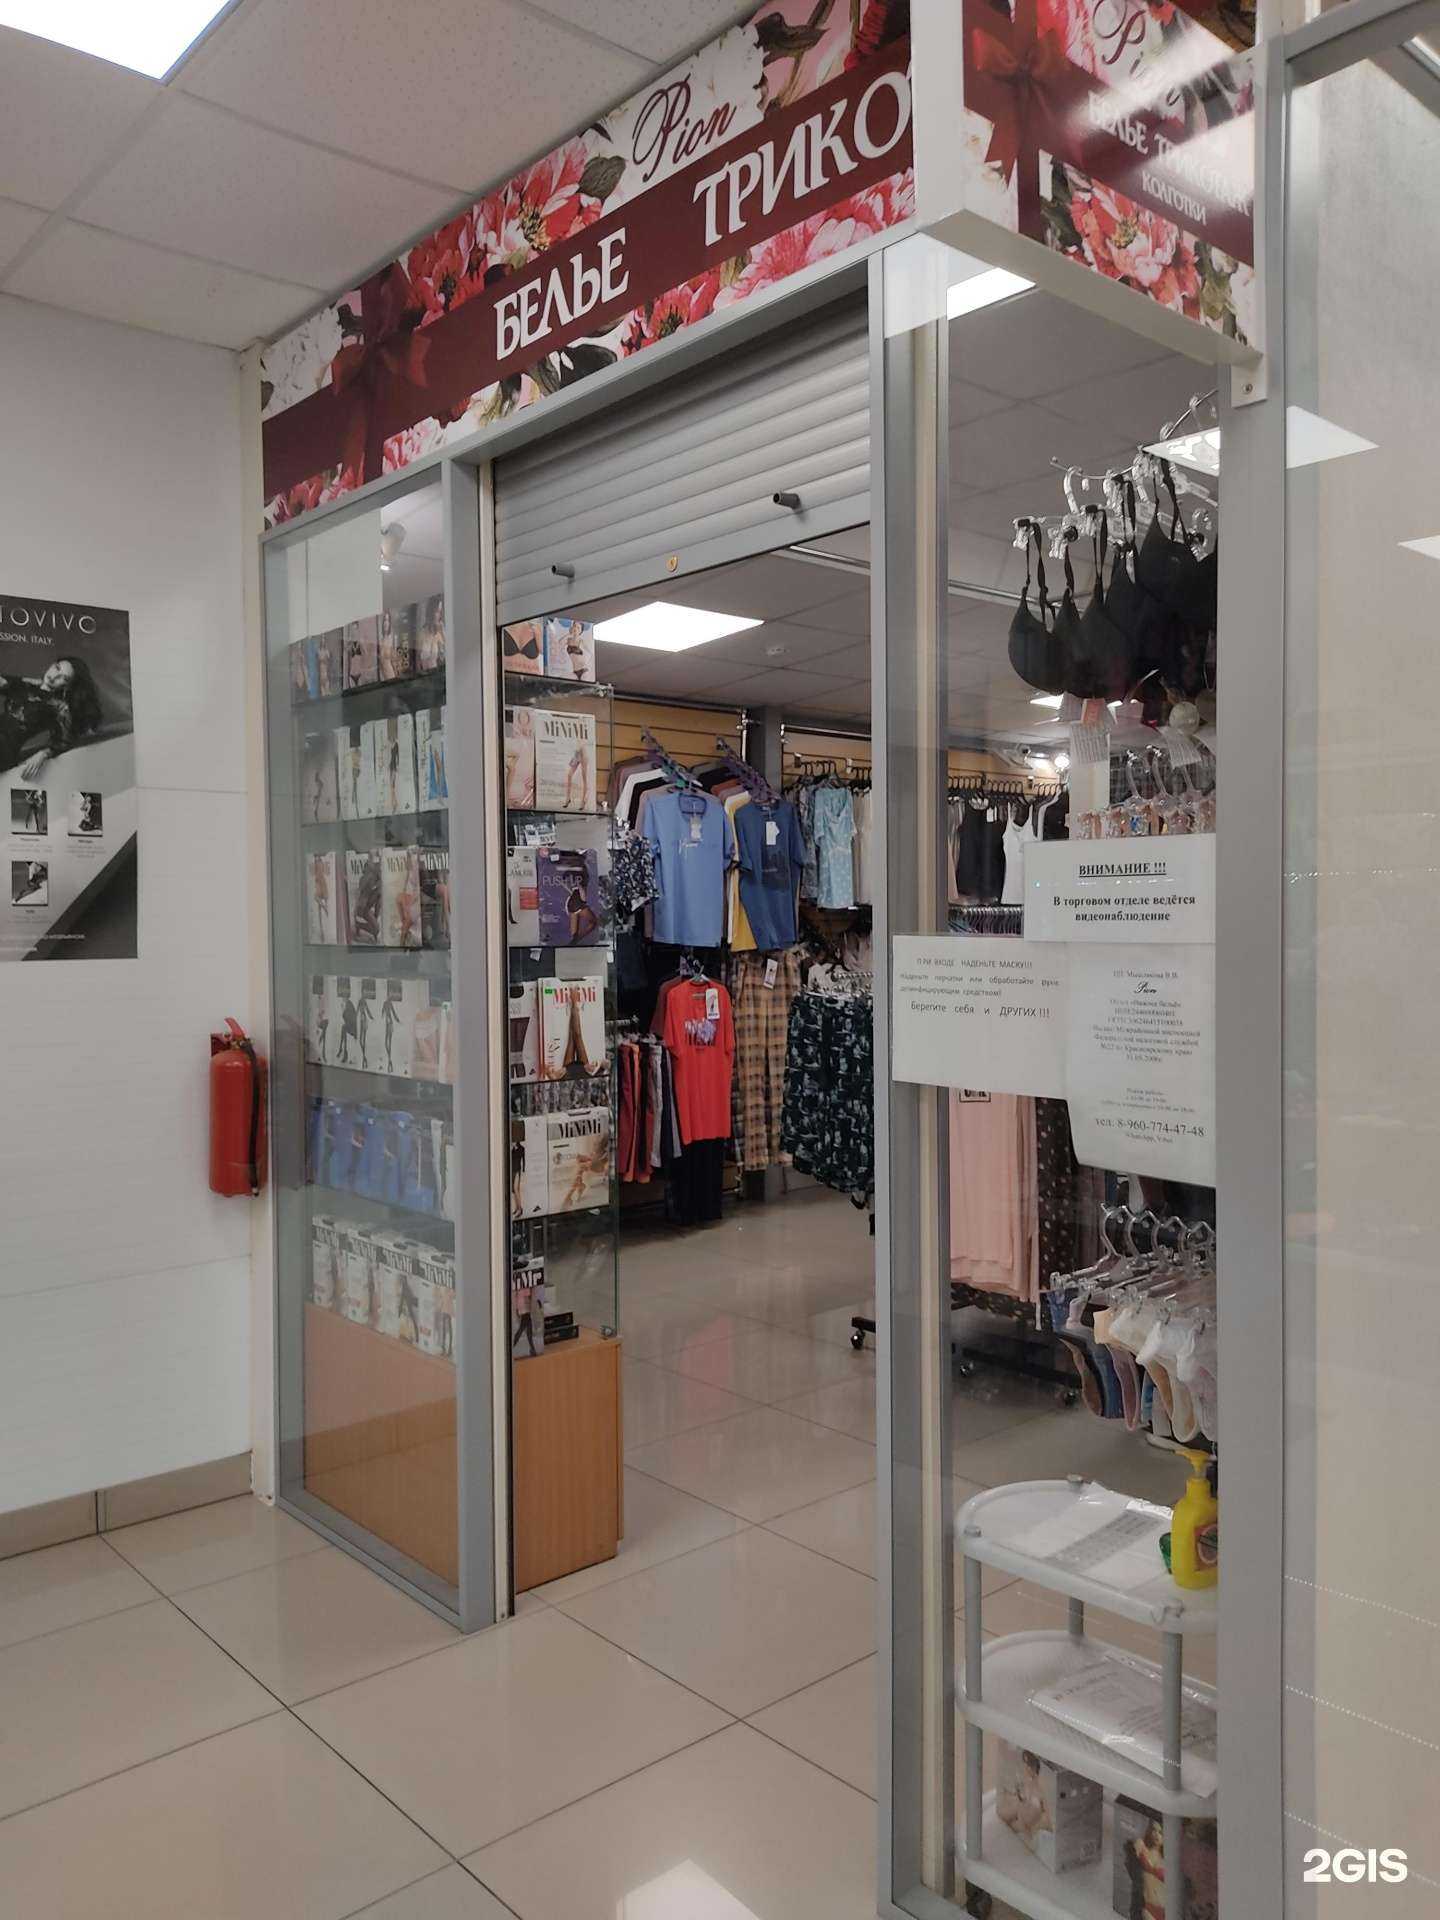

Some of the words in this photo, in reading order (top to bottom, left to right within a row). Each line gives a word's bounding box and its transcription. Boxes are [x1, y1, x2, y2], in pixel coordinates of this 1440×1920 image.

[632, 73, 737, 182] Pion
[1142, 170, 1206, 226] КОЛГОТКИ
[493, 227, 629, 360] БЕЛЬЕ
[692, 60, 912, 247] ТРИКО
[1079, 863, 1150, 876] ВНИМАНИЕ
[1154, 862, 1166, 873] !!!
[1053, 896, 1061, 906] В
[1064, 897, 1111, 908] торговом
[1114, 897, 1150, 906] отделе
[1153, 894, 1196, 905] ведётся
[1075, 910, 1171, 922] видеонаблюдение
[954, 1004, 975, 1014] себя
[1000, 1007, 1036, 1018] ДРУГИХ
[1117, 1119, 1205, 1137] 8-960-774-47-48
